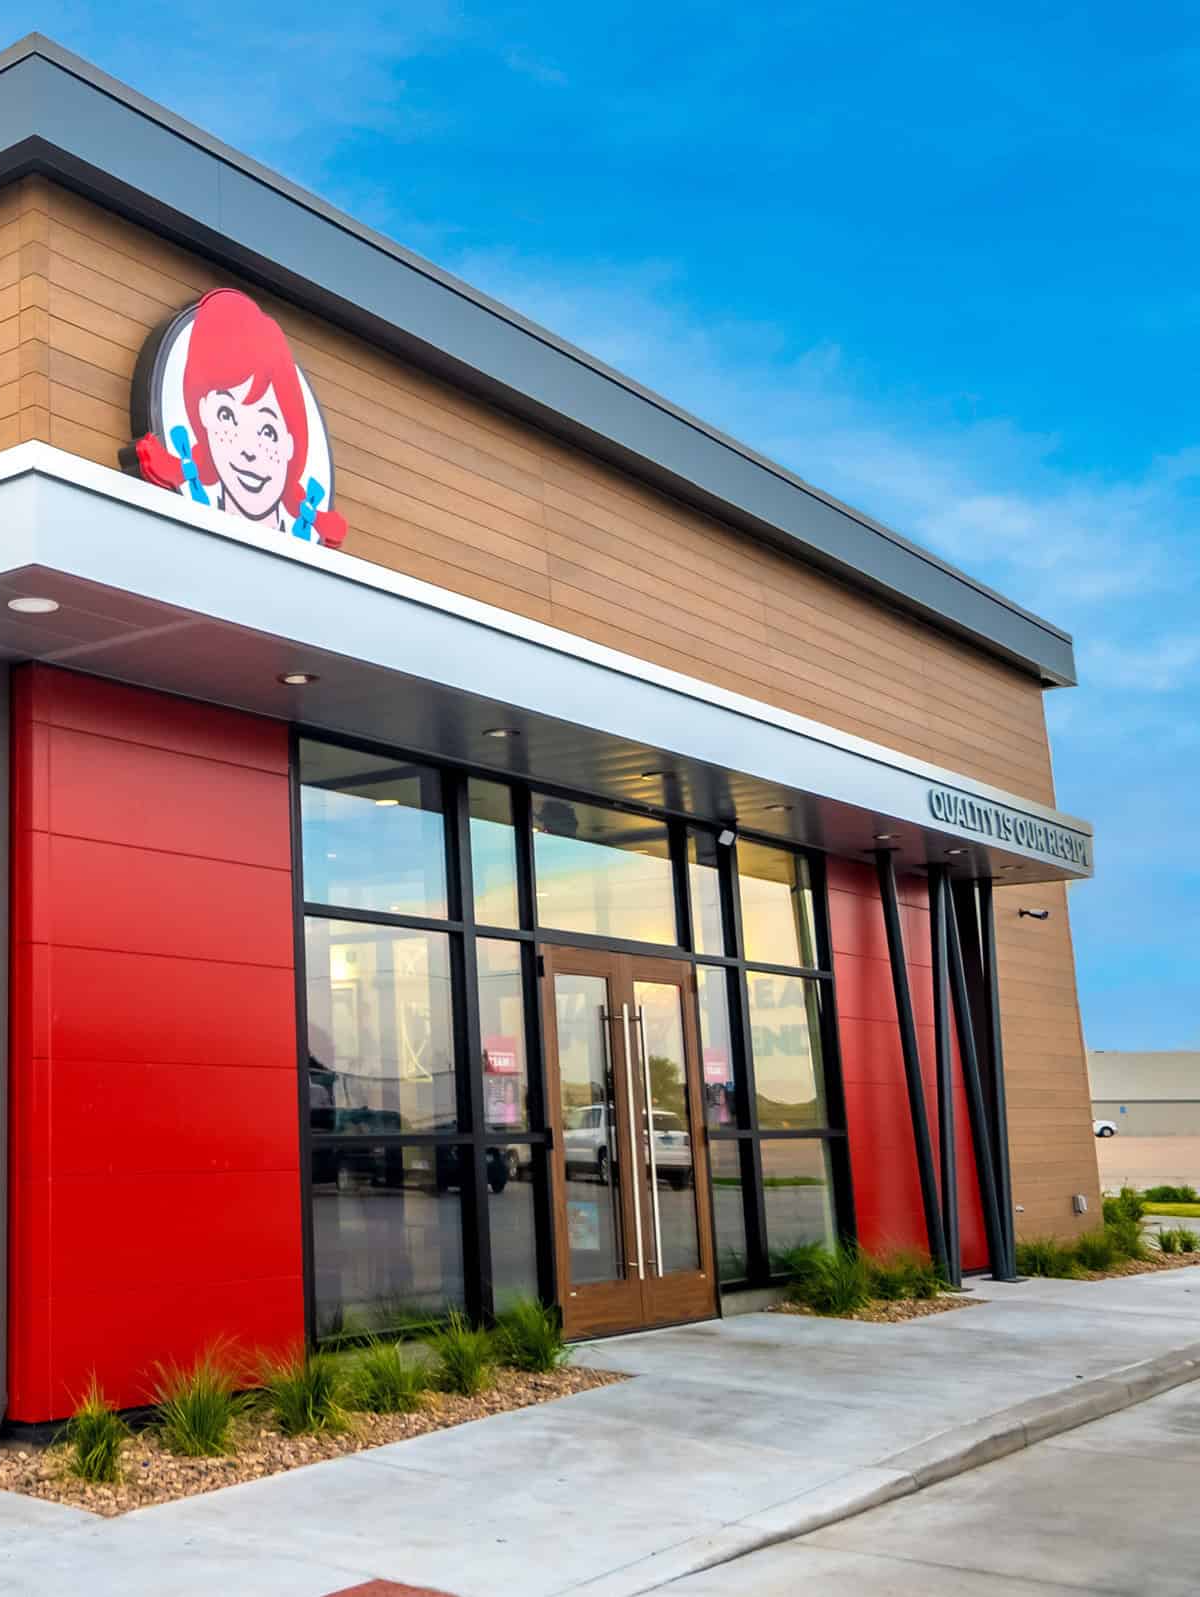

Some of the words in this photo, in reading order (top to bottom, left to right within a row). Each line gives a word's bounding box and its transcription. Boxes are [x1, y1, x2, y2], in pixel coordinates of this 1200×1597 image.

[928, 788, 994, 836] QUALITY
[994, 810, 1012, 842] IS
[1012, 816, 1045, 853] OUR
